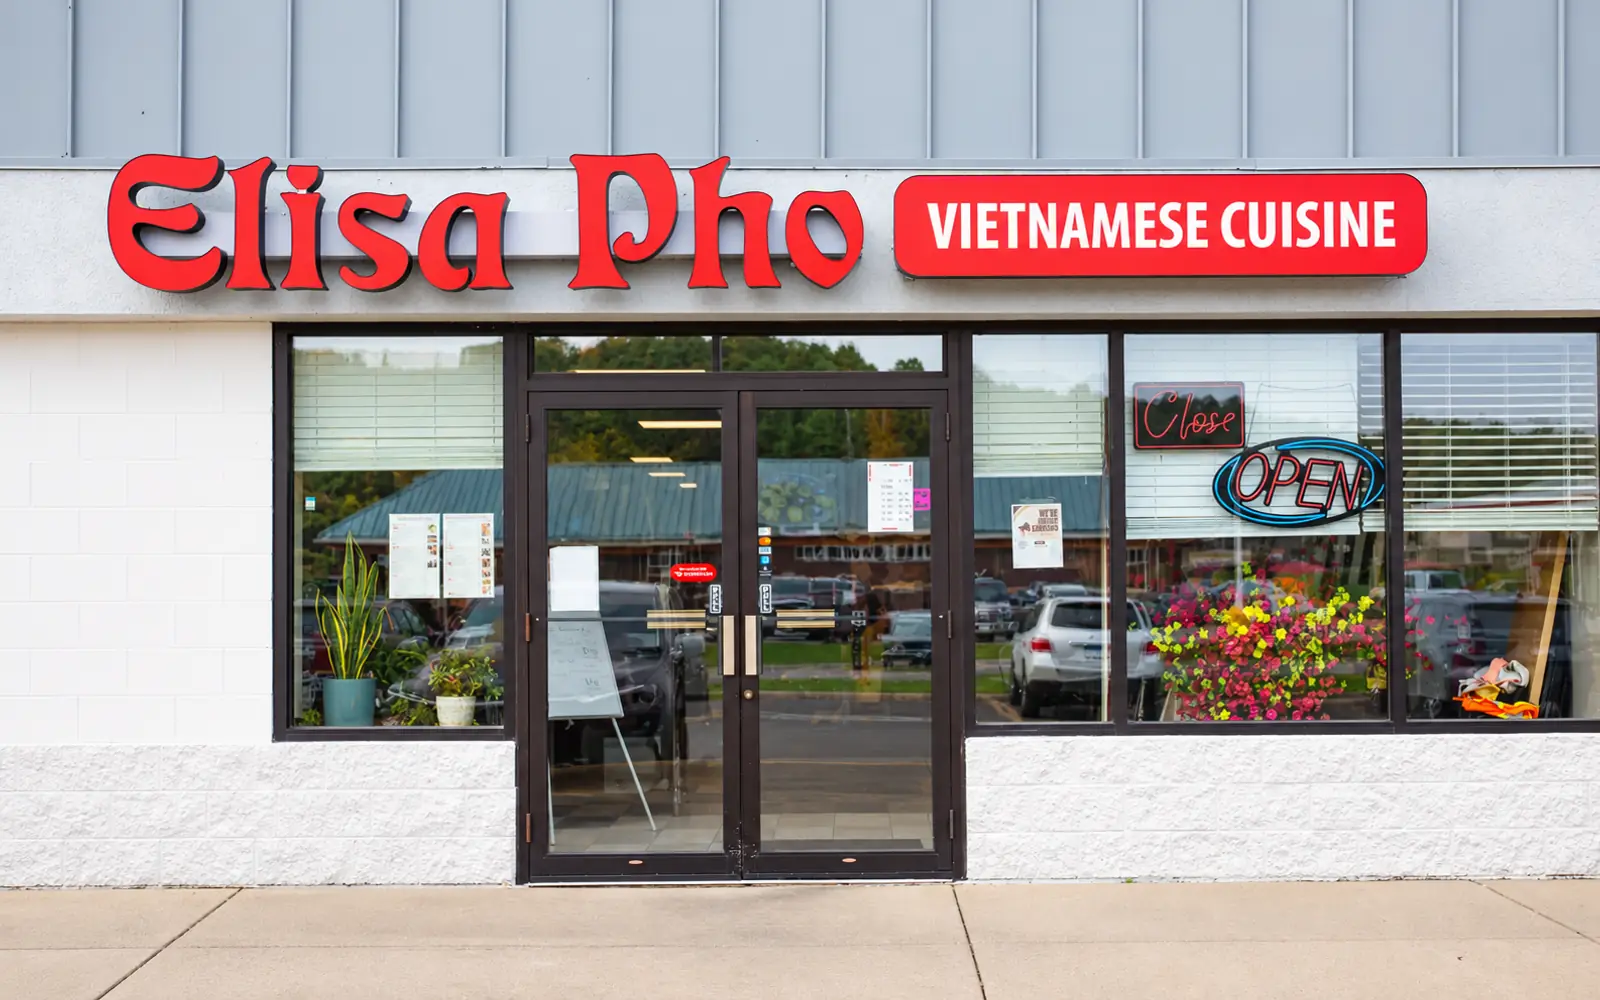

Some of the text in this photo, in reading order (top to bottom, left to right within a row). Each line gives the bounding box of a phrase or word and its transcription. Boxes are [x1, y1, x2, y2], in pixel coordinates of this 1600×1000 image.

[107, 153, 864, 292] Elisa Pho
[927, 200, 1397, 250] VIETNAMESE CUISINE
[1143, 390, 1236, 440] Close
[1235, 452, 1364, 512] OPEN
